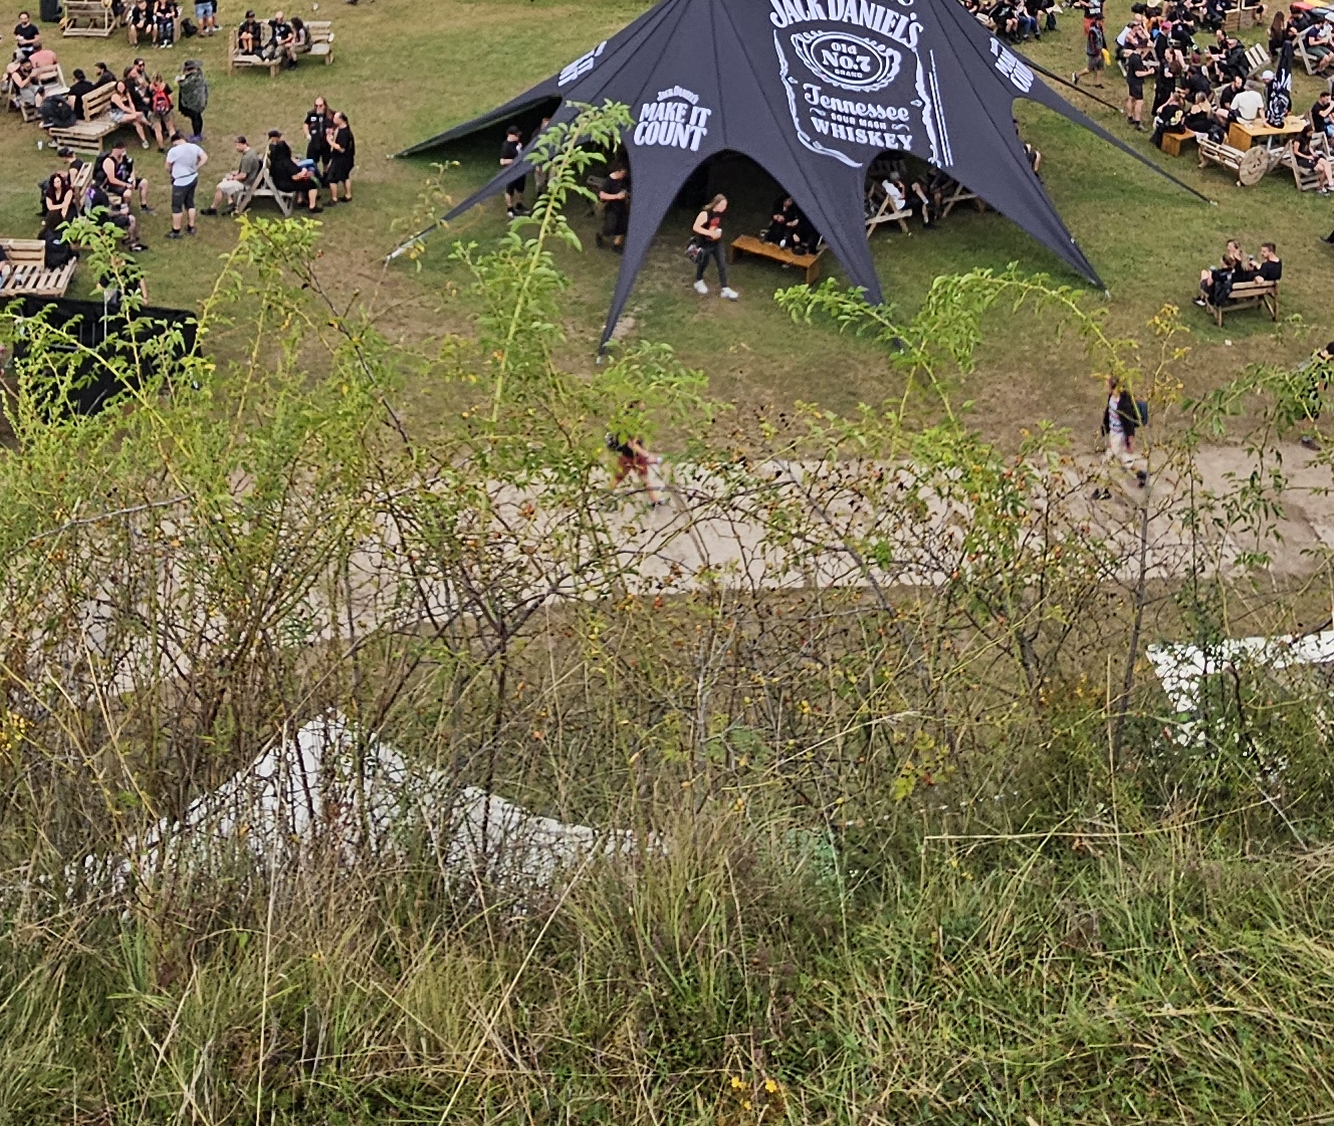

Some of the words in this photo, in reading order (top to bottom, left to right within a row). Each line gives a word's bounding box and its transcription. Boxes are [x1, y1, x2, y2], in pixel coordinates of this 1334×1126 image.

[830, 41, 858, 55] Old
[639, 102, 688, 123] MAKE
[689, 105, 712, 128] IT
[802, 82, 910, 122] Tennessee
[633, 120, 708, 152] COUNT
[810, 116, 913, 151] WHISKEY
